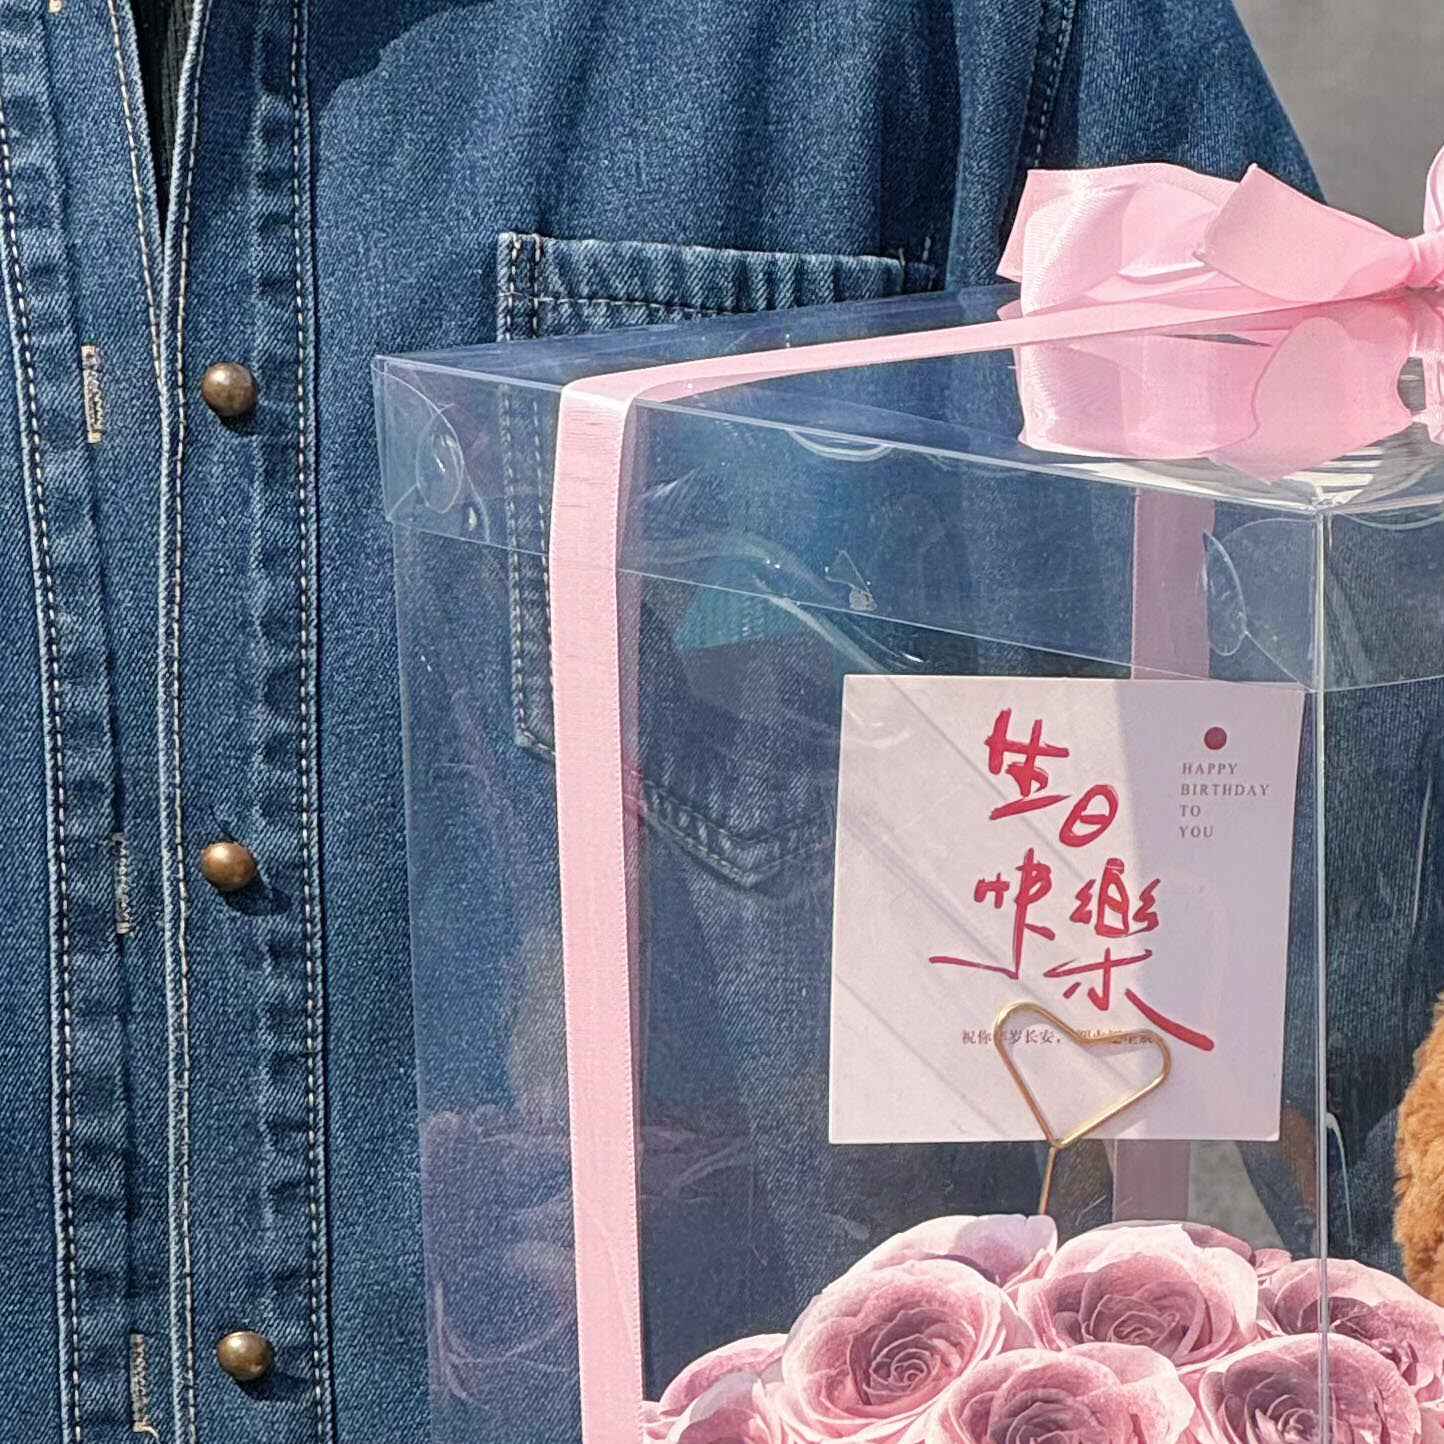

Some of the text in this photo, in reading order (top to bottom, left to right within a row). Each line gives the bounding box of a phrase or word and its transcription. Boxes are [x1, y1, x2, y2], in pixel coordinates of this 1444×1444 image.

[1181, 762, 1239, 776] HAPPY
[1180, 783, 1271, 797] BIRTHDAY
[1178, 804, 1202, 818] TO
[1178, 825, 1215, 839] YOU
